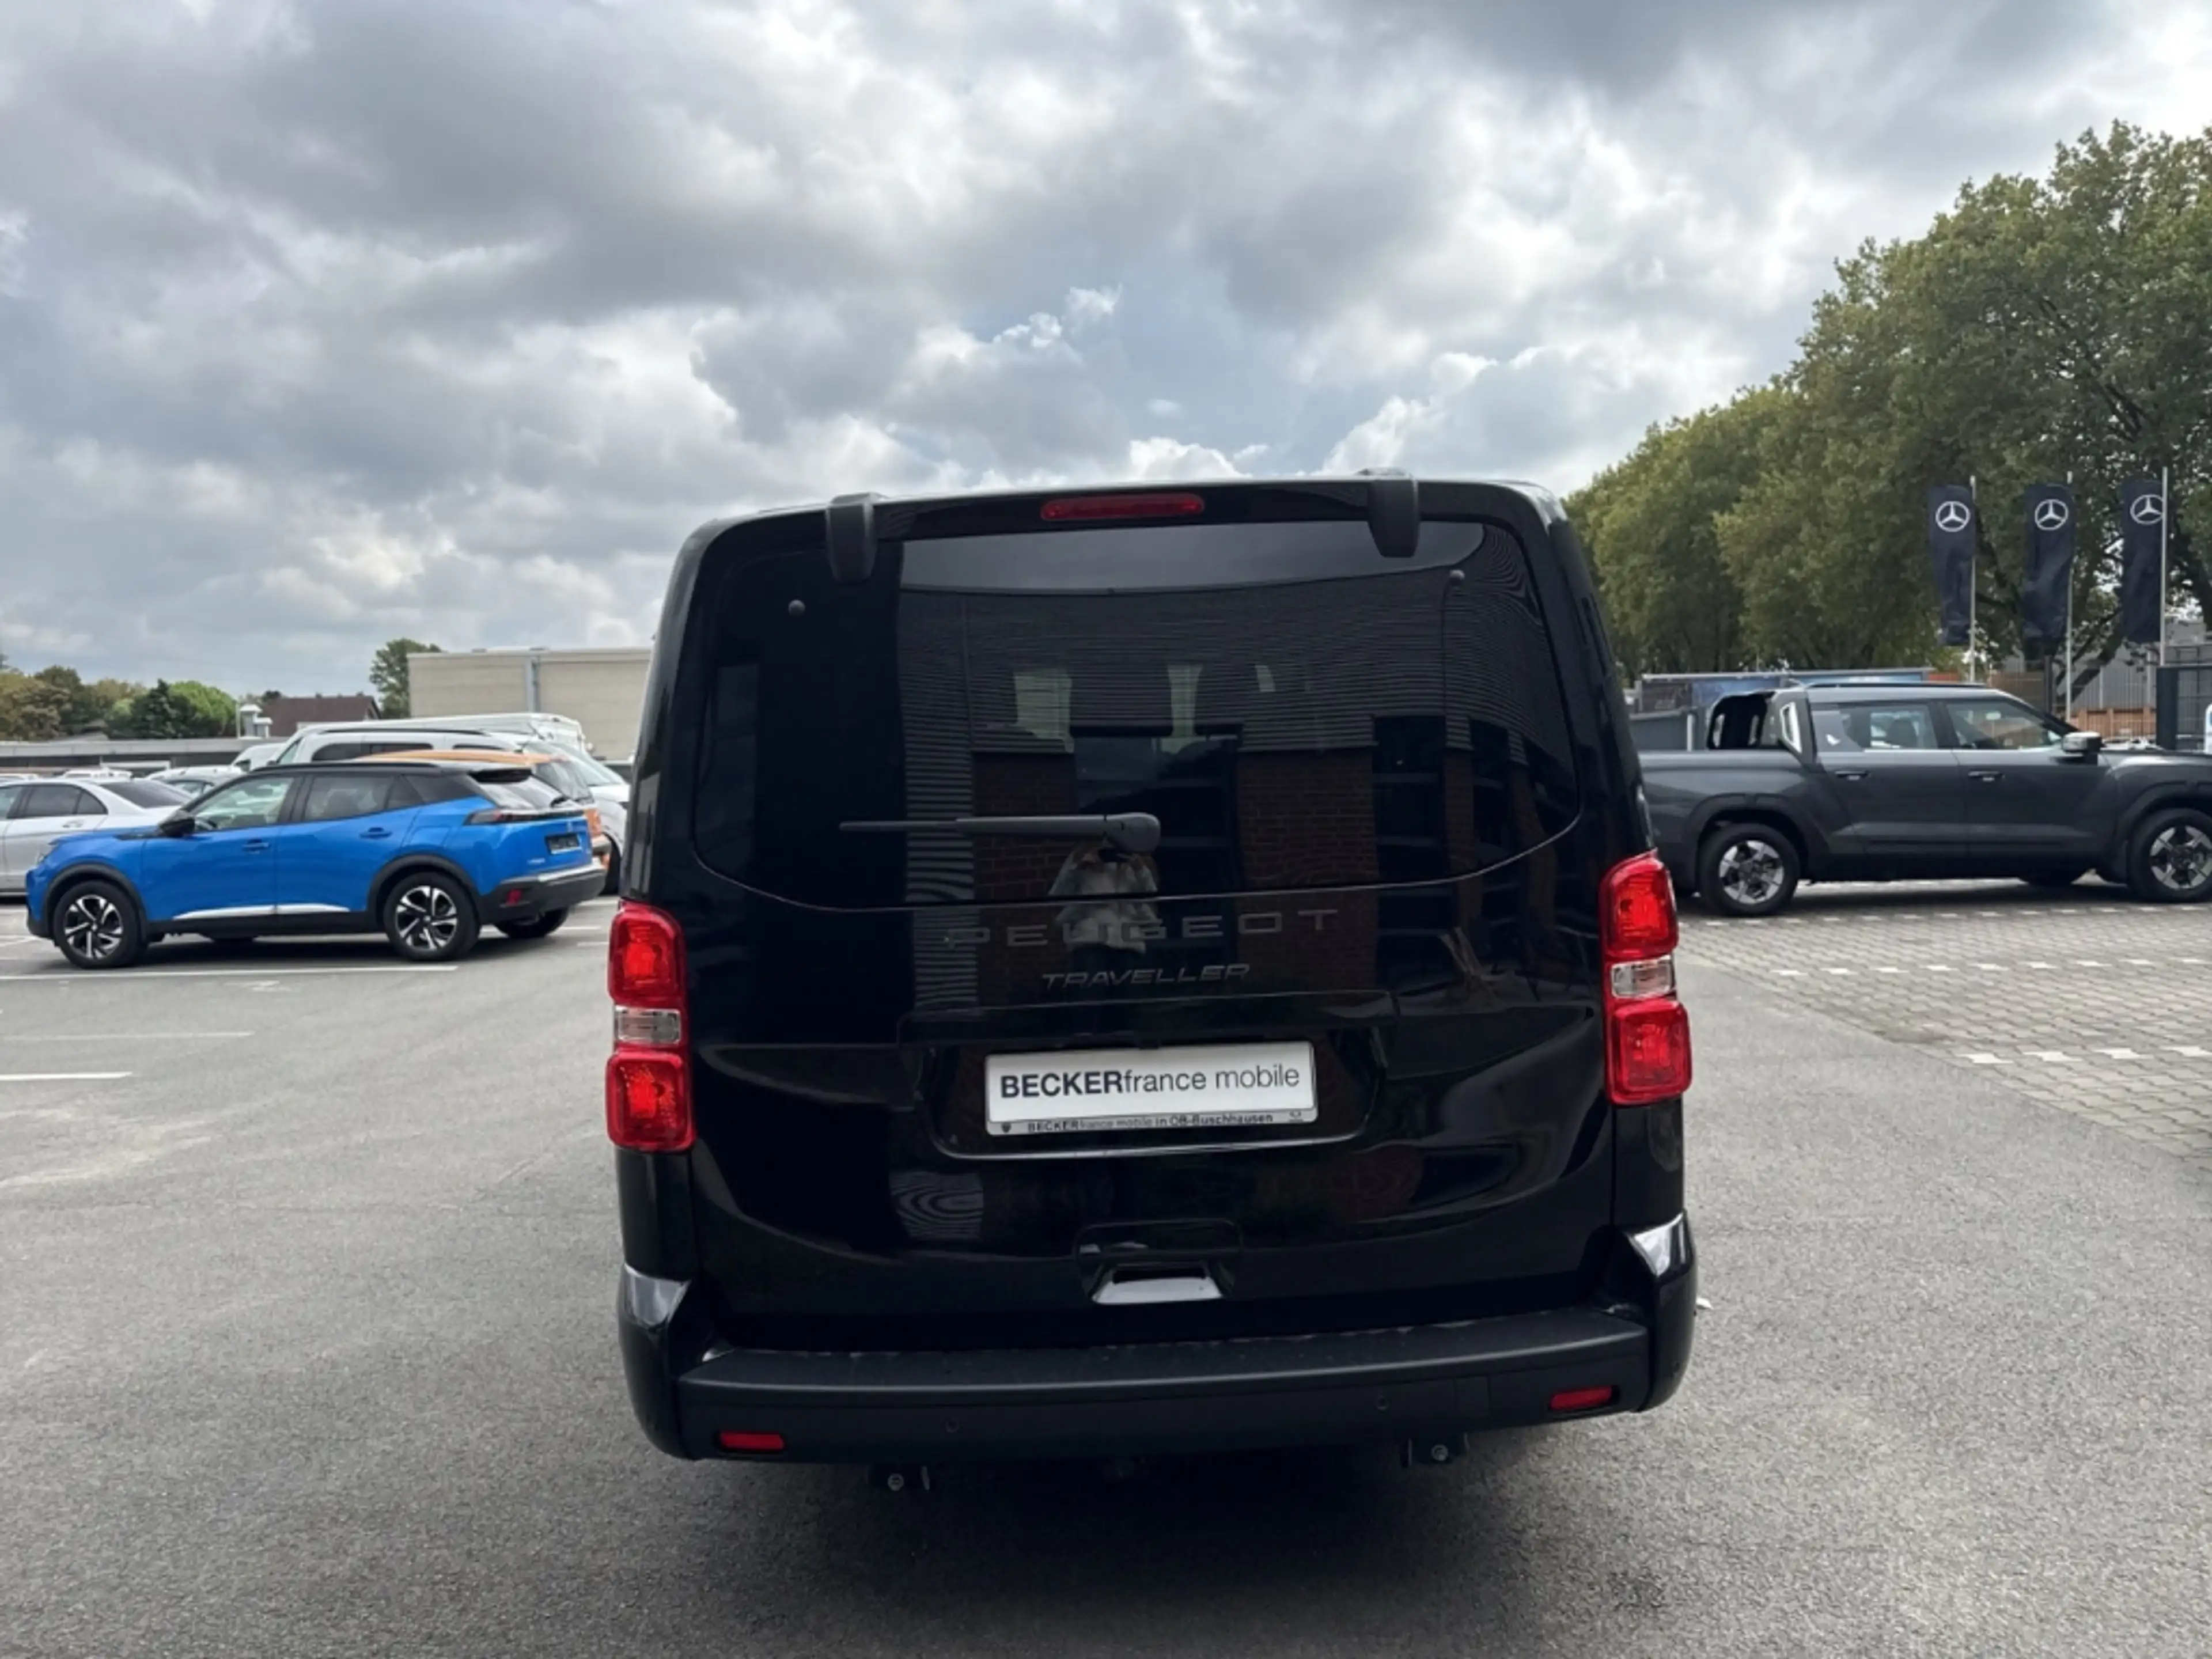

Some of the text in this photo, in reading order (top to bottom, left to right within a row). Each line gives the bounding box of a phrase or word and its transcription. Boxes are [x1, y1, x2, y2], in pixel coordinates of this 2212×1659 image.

[948, 908, 1339, 950] PEUGEOT
[1041, 964, 1250, 989] TRAVELLER
[1001, 1064, 1300, 1098] BECKERfrance mobile
